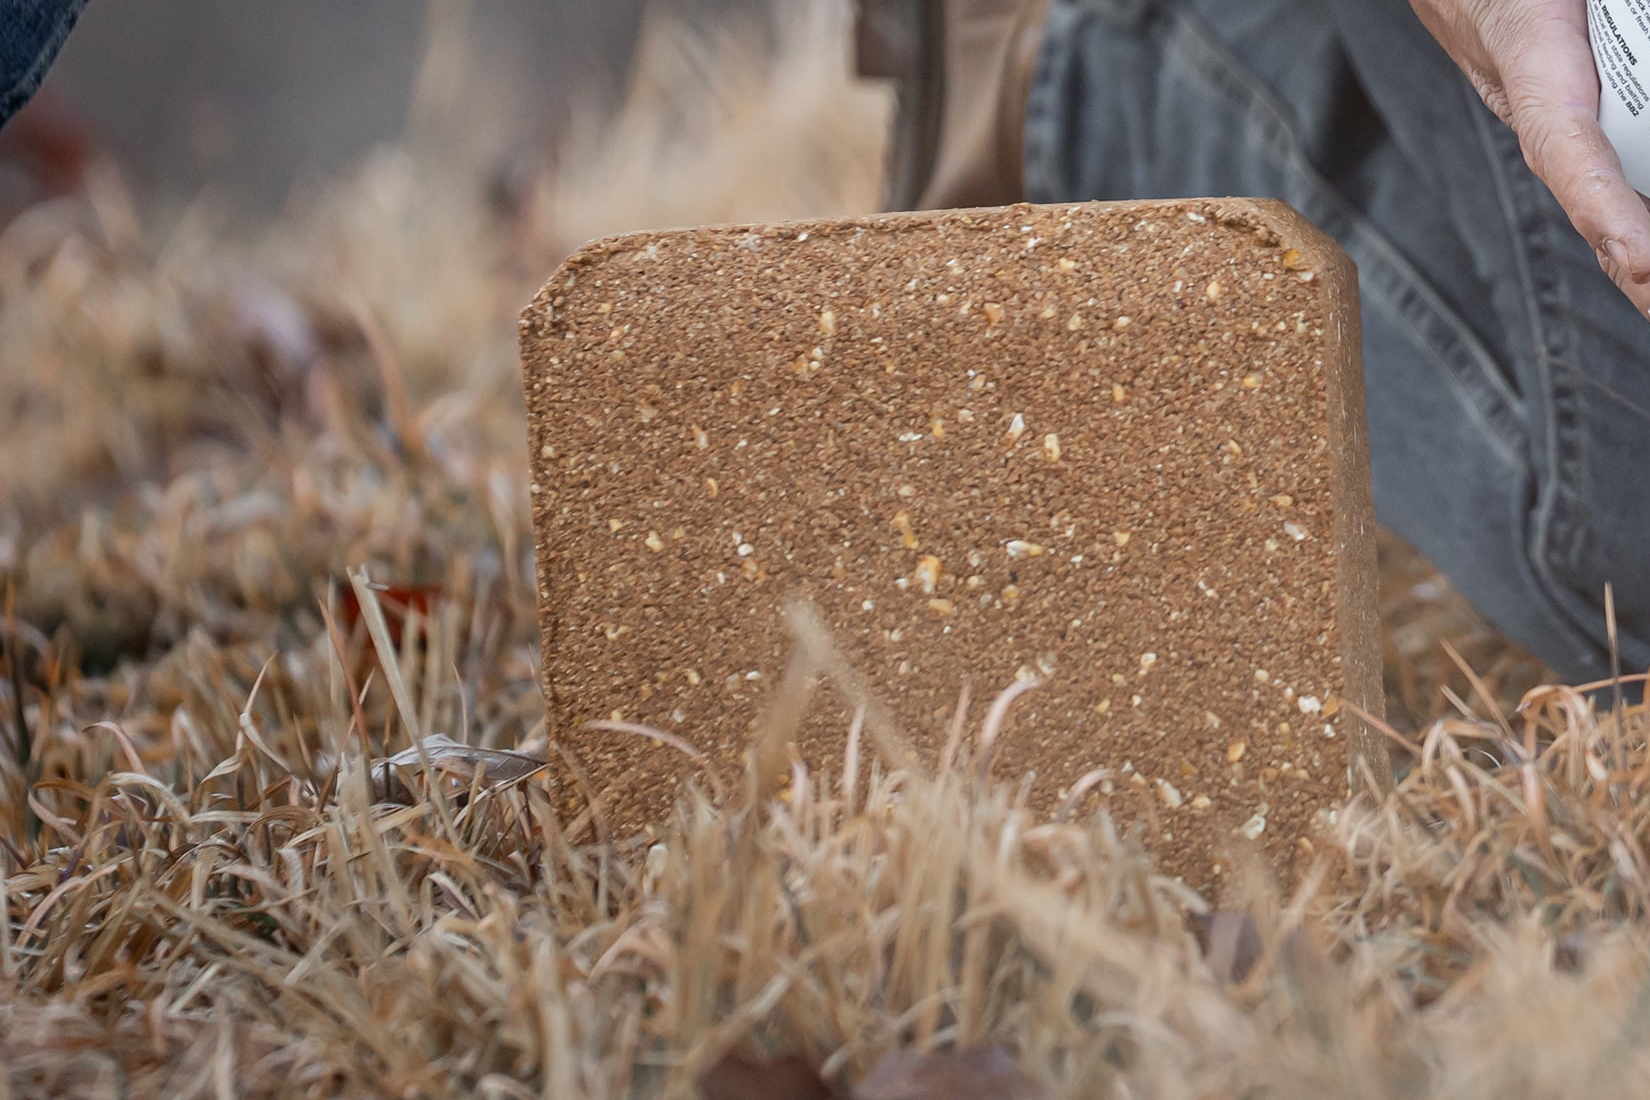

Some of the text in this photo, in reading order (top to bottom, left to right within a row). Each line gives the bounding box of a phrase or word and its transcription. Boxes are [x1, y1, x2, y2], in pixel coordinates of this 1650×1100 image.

[1601, 5, 1637, 66] REGULATIONS
[1630, 7, 1638, 15] or
[1635, 15, 1649, 35] fresh
[1604, 30, 1614, 44] and
[1611, 45, 1623, 63] state
[1622, 63, 1650, 102] regulations
[1605, 69, 1639, 117] using the BB2
[1615, 71, 1628, 85] and
[1625, 84, 1644, 110] baiting
